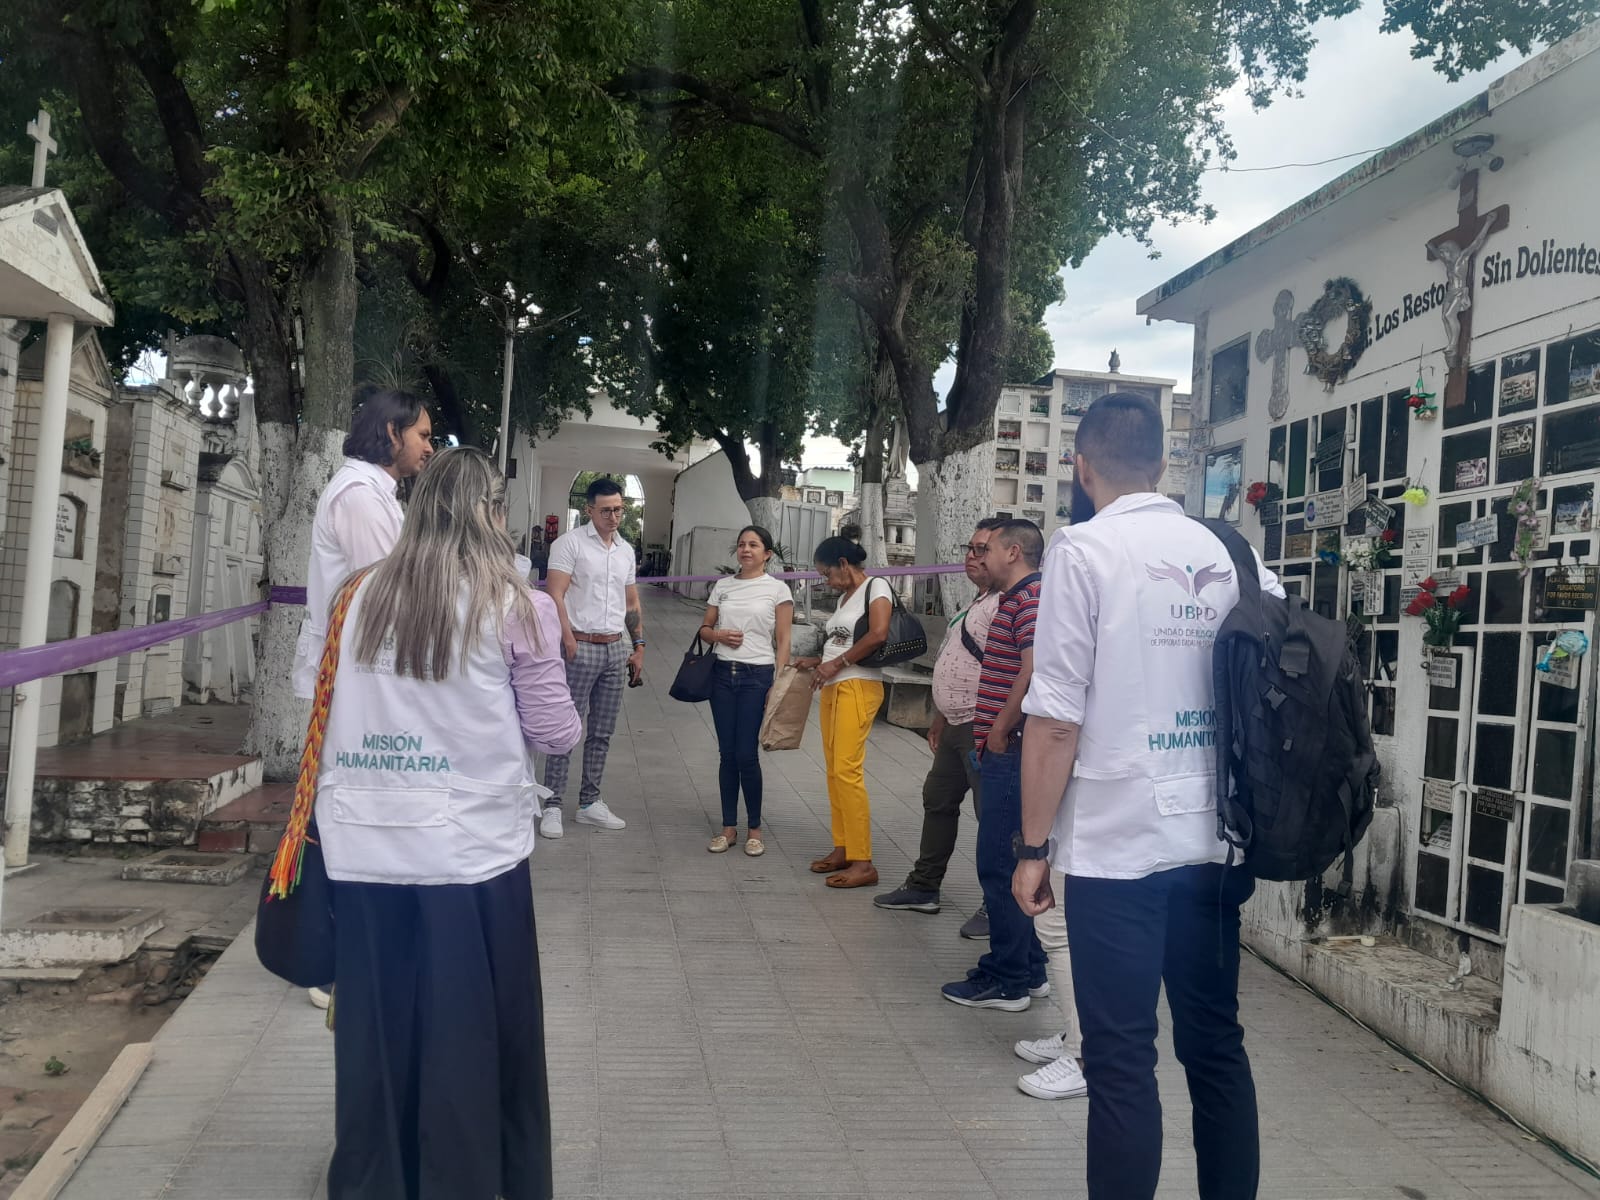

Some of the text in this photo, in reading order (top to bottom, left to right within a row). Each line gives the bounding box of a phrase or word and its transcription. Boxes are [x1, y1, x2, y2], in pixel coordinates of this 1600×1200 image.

[1375, 307, 1400, 341] Los
[1481, 251, 1512, 289] Sin
[1170, 604, 1218, 621] UBPD
[1153, 627, 1184, 637] UNIDAD
[362, 731, 423, 752] MISIÓN
[335, 751, 451, 772] HUMANITARIA
